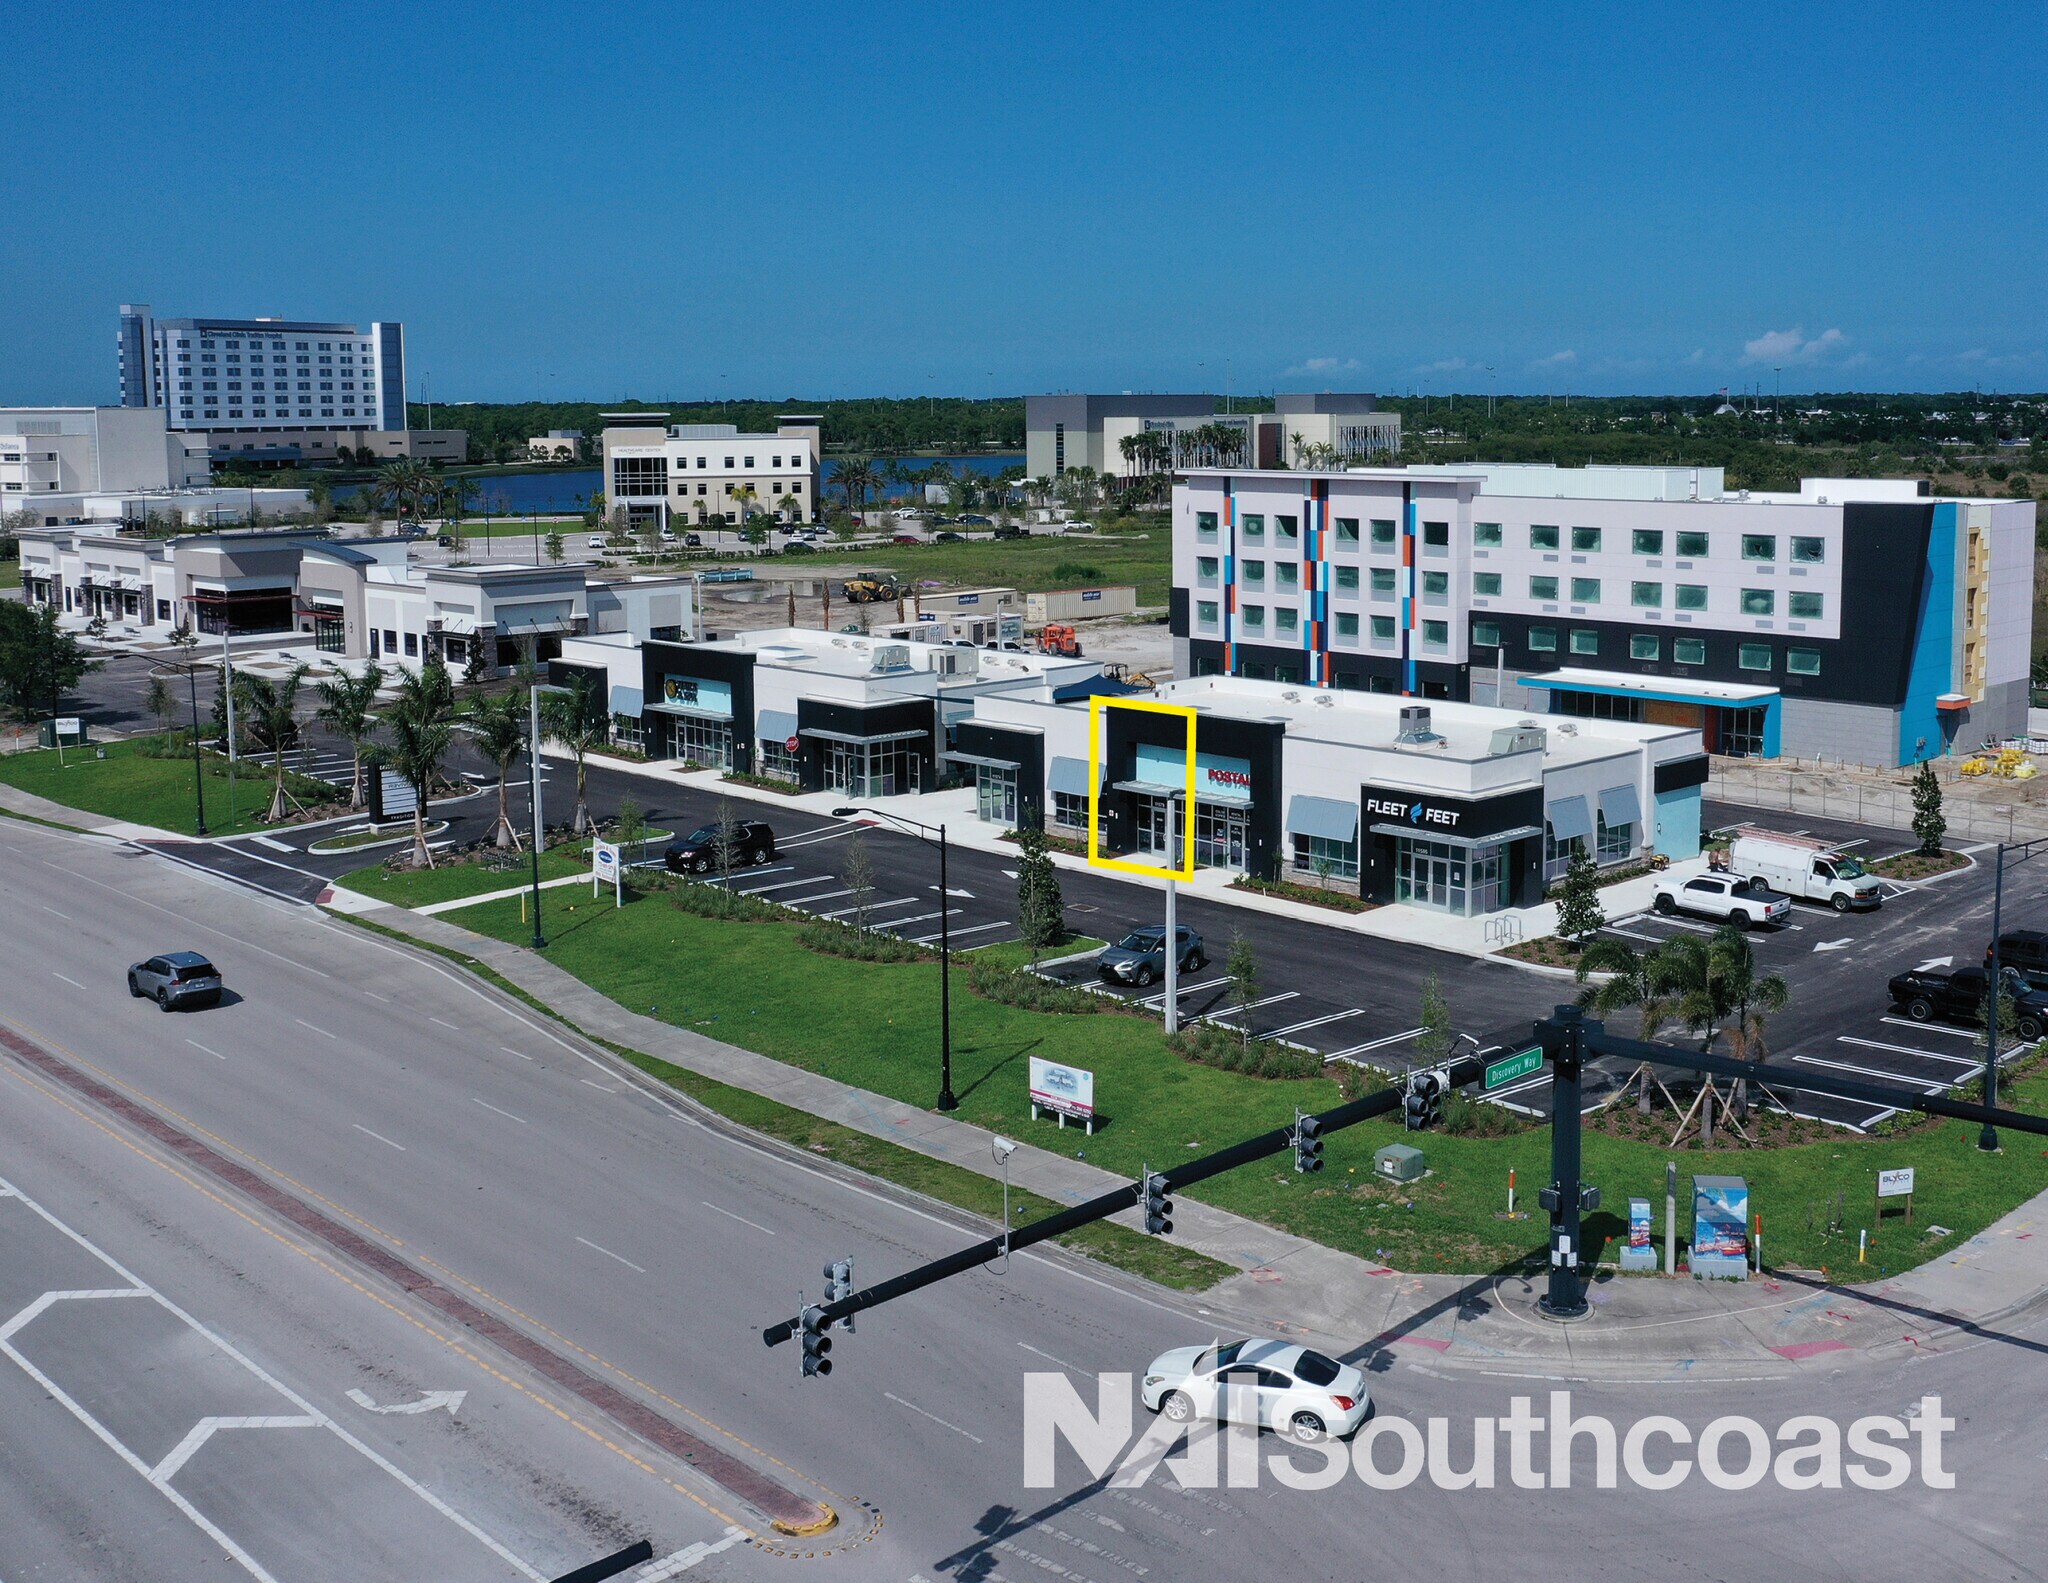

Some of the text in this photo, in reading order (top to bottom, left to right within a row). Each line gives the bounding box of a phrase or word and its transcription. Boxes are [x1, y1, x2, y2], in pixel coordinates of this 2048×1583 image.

[1367, 799, 1460, 826] FLEET FEET
[1492, 1057, 1536, 1081] Discovery Way
[1883, 1173, 1909, 1182] BLYCO
